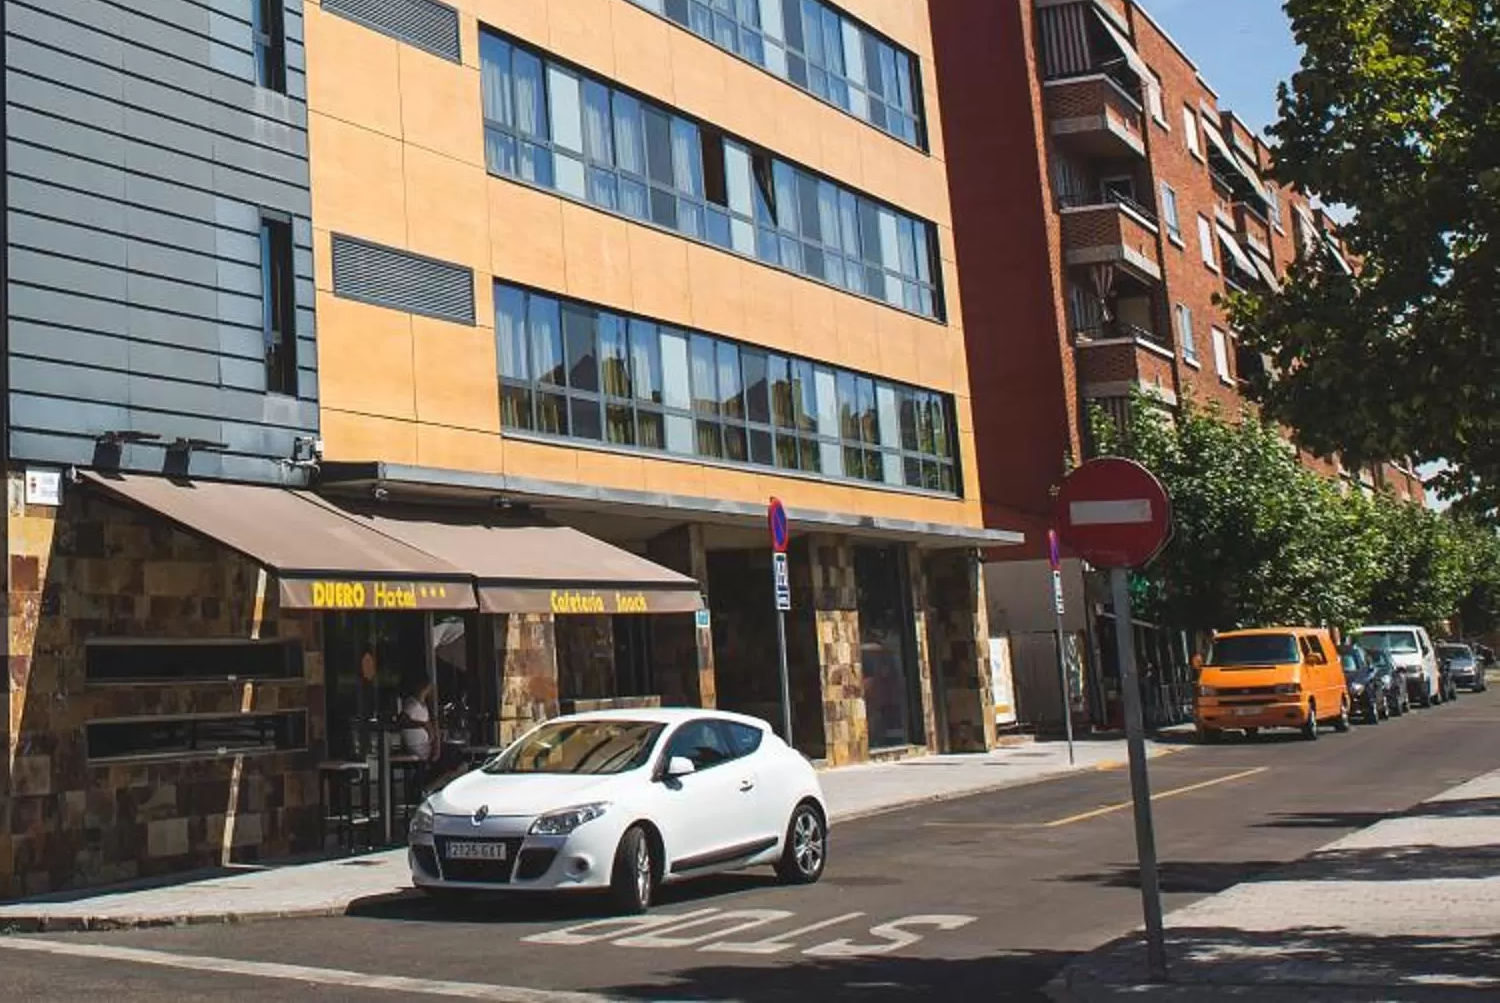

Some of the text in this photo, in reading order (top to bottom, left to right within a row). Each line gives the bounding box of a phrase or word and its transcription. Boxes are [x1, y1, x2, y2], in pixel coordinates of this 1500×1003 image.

[312, 580, 417, 609] DUERO Hotel
[518, 907, 980, 957] STOP
